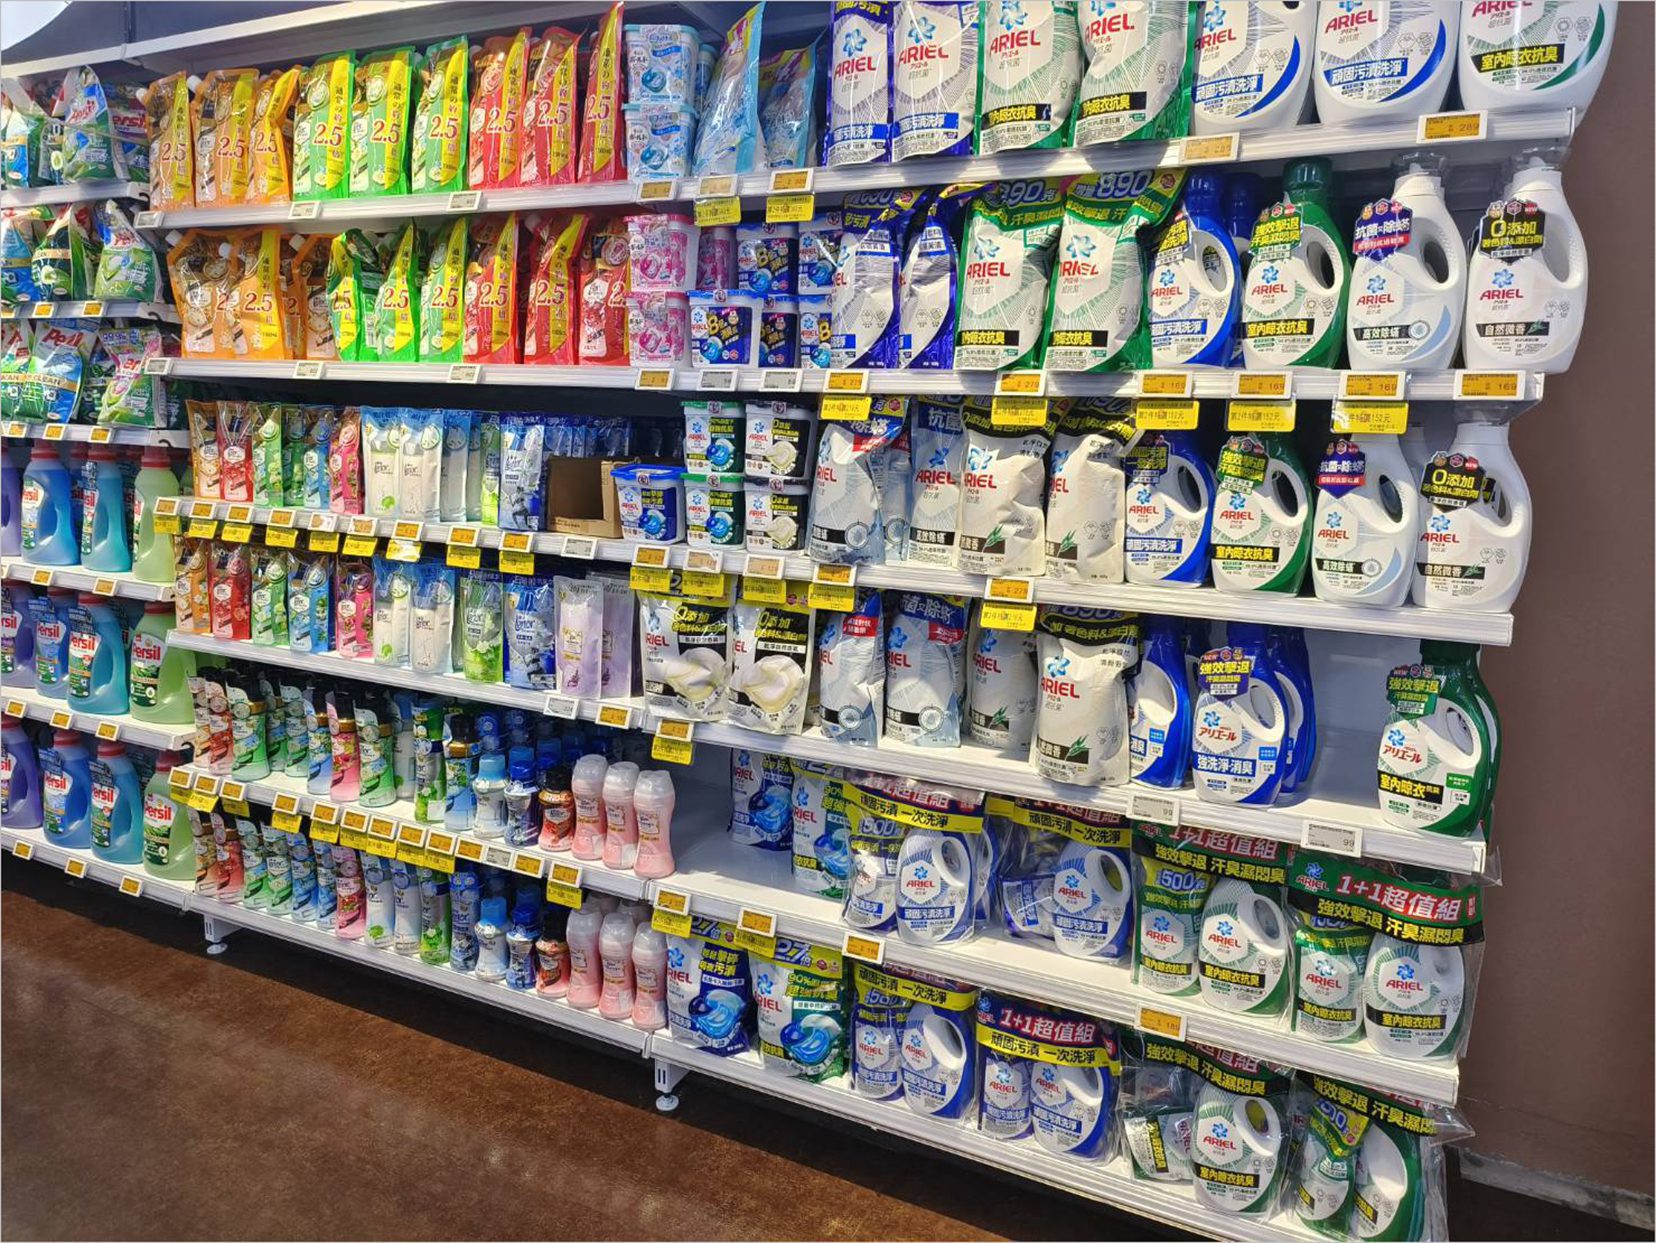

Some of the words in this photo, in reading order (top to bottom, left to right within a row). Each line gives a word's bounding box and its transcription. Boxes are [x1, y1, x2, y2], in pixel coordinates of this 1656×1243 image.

[1084, 14, 1135, 41] ARIEL
[1324, 10, 1378, 33] ARIEL
[989, 29, 1041, 55] ARIEL
[1194, 29, 1236, 49] ARIEL
[897, 46, 949, 65] ARIEL
[834, 56, 877, 78] ARIEL
[538, 100, 568, 125] 2.5
[585, 96, 611, 121] 2.5
[113, 115, 147, 129] ersil
[430, 116, 458, 139] 2.5
[486, 109, 517, 133] 2.5
[257, 132, 278, 153] 2.5
[313, 123, 343, 146] 2.5
[371, 123, 400, 145] 2.5
[161, 142, 186, 163] 2.5
[217, 135, 244, 158] 2.5
[1099, 171, 1151, 199] 890
[966, 262, 1011, 279] ARIEL
[382, 288, 409, 309] 2.5
[431, 287, 459, 309] 2.5
[478, 283, 508, 307] 2.5
[535, 280, 565, 306] 2.5
[608, 282, 628, 307] 2.
[1151, 287, 1183, 296] ARIEL
[1251, 284, 1288, 295] ARIEL
[1480, 290, 1524, 300] ARIEL
[244, 293, 272, 312] 2.5
[1356, 294, 1395, 305] ARIEL
[1484, 323, 1526, 336] 自然微香
[816, 467, 837, 483] RIEL
[915, 470, 956, 485] ARIEL
[1432, 469, 1476, 488] 0添加
[1129, 505, 1159, 514] ARIEL
[1220, 511, 1255, 520] ARIEL
[1318, 529, 1349, 540] ARIEL
[1420, 533, 1460, 544] ARIEL
[1424, 566, 1463, 577] 自然微香
[1040, 677, 1080, 699] ARIEL
[1198, 726, 1237, 741] アリエール
[1384, 745, 1422, 764] アリエール
[901, 808, 949, 827] 一次洗淨
[1029, 813, 1072, 834] 頑固污漬
[1074, 827, 1121, 843] 一次洗淨
[1343, 838, 1355, 846] 99
[906, 879, 936, 888] ARIEL
[1296, 875, 1329, 891] ARIEL
[1058, 887, 1087, 900] ARIEL
[1337, 875, 1463, 921] 1+1超值組
[1318, 899, 1383, 929] 強效擊退
[1386, 919, 1464, 944] 汗臭濕悶臭
[1146, 931, 1177, 944] ARIEL
[1208, 934, 1241, 949] ARIEL
[859, 966, 898, 993] 頑固污漬
[902, 983, 947, 1004] 一次洗淨
[1306, 973, 1342, 989] ARIEL
[1386, 980, 1423, 992] ARIEL
[1001, 1009, 1096, 1042] 1+1超值組
[859, 1043, 883, 1056] ARIEL
[905, 1044, 927, 1059] ARIEL
[991, 1031, 1040, 1057] 頑固污漬
[1044, 1048, 1096, 1065] 一次洗淨
[1146, 1044, 1199, 1070] 強效擊退
[990, 1080, 1018, 1094] ARIEL
[1036, 1078, 1060, 1094] ARIEL
[1372, 1103, 1437, 1136] 汗臭濕悶
[1203, 1135, 1237, 1150] ARIEL
